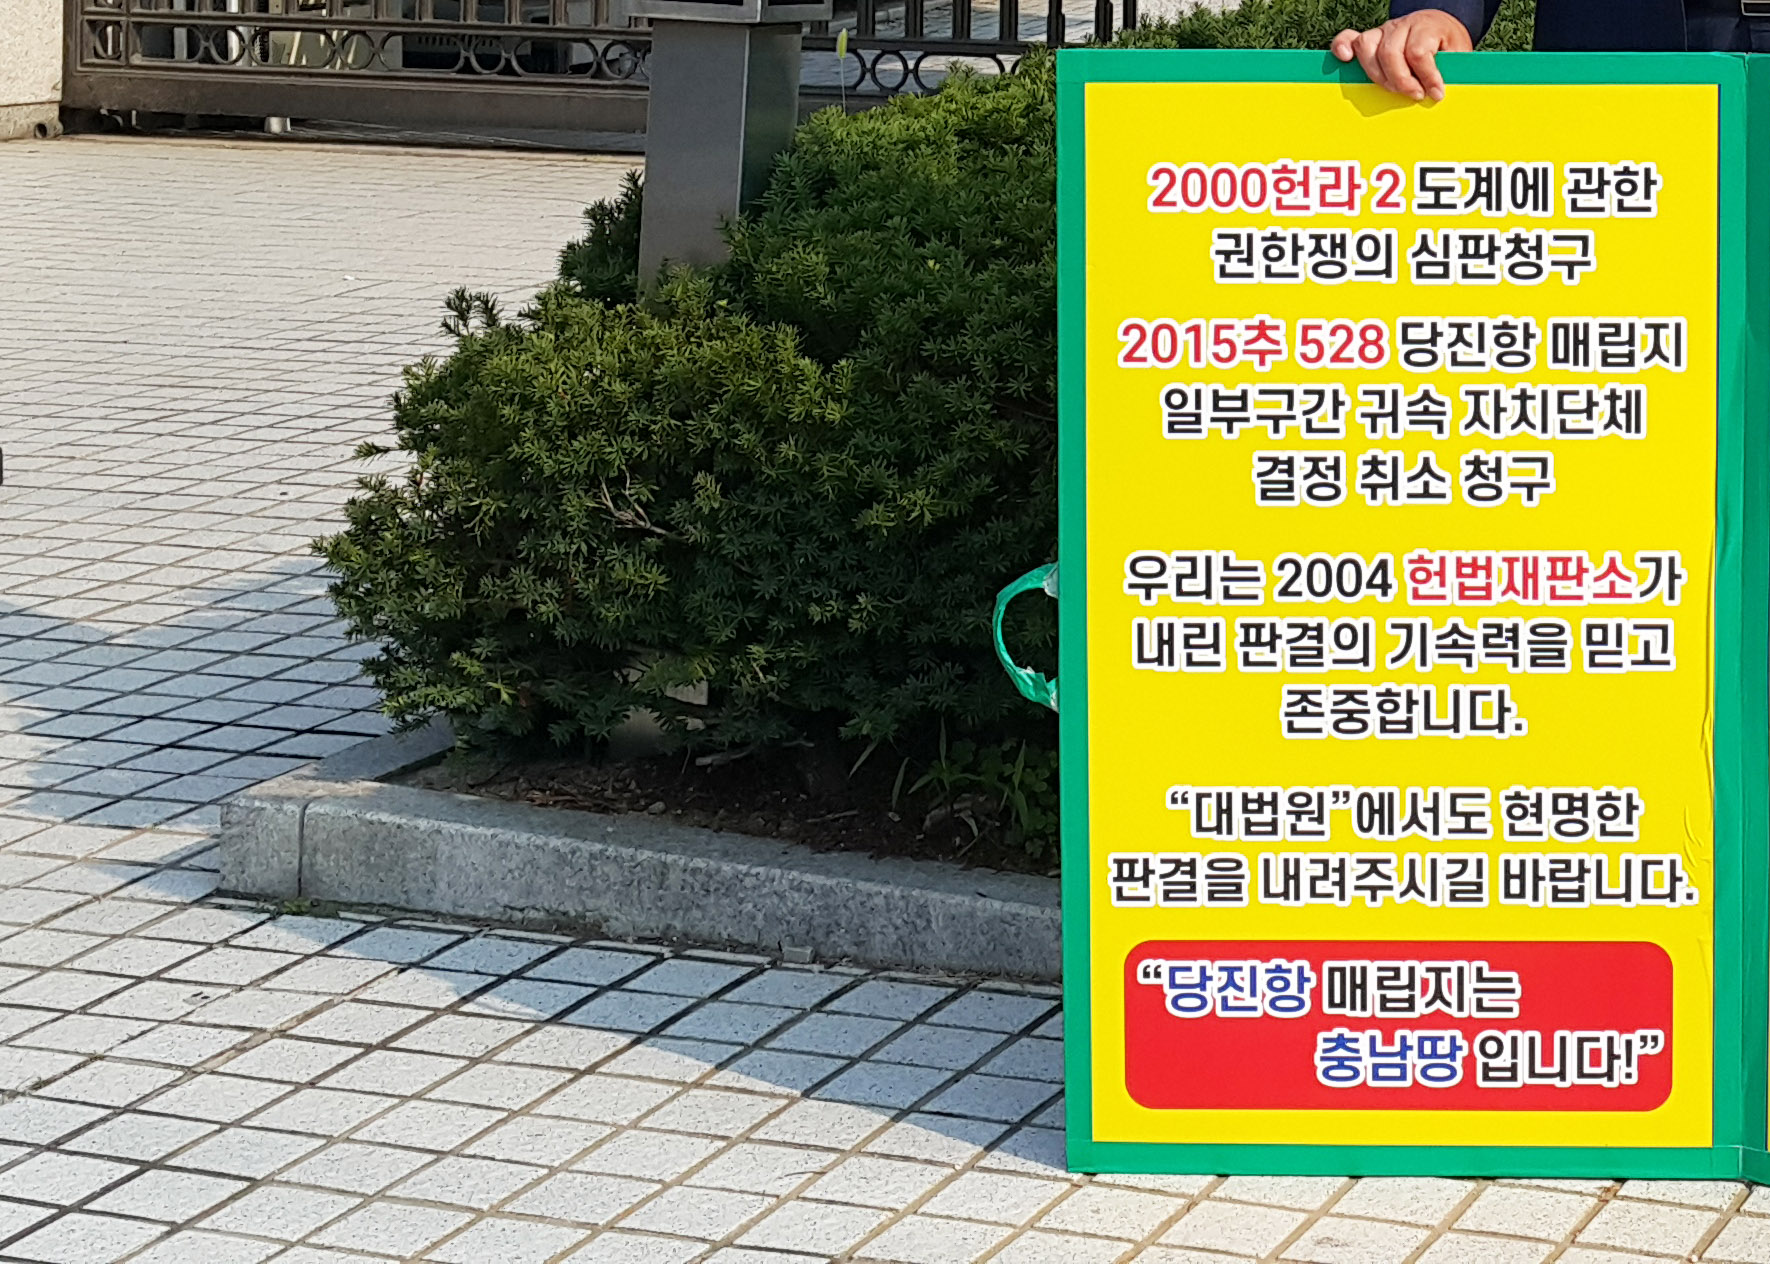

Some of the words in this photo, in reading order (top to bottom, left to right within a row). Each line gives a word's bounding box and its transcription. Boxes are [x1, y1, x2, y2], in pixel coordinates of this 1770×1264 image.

[1151, 163, 1362, 212] 2000헌라
[1374, 168, 1402, 209] 2
[1416, 165, 1550, 213] 도계에
[1566, 164, 1659, 214] 관한
[1214, 230, 1393, 280] 권한쟁의
[1410, 232, 1592, 281] 심판청구
[1121, 318, 1283, 368] 2015추
[1299, 323, 1386, 365] 528
[1400, 320, 1537, 369] 당진항
[1551, 321, 1683, 369] 매립지
[1163, 387, 1347, 435] 일부구간
[1359, 388, 1448, 436] 귀속
[1463, 387, 1642, 436] 자치단체
[1255, 455, 1343, 503] 결정
[1359, 453, 1448, 502] 취소
[1463, 454, 1551, 503] 청구
[1127, 554, 1262, 602] 우리는
[1276, 557, 1394, 599] 2004
[1407, 554, 1683, 602] 헌법재판소가
[1136, 621, 1222, 668] 내린
[1238, 621, 1371, 669] 판결의
[1389, 621, 1569, 669] 기속력을
[1585, 622, 1672, 669] 믿고
[1283, 686, 1524, 736] 존중합니다.
[1169, 789, 1489, 837] “대법원”에서도
[1503, 790, 1640, 839] 현명한
[1111, 856, 1246, 903] 판결을
[1262, 856, 1485, 904] 내려주시길
[1502, 857, 1695, 904] 바랍니다.
[1141, 963, 1312, 1014] “당진항
[1326, 964, 1517, 1014] 매립지는
[1318, 1032, 1464, 1083] 충남땅
[1477, 1034, 1660, 1083] 입니다!”
